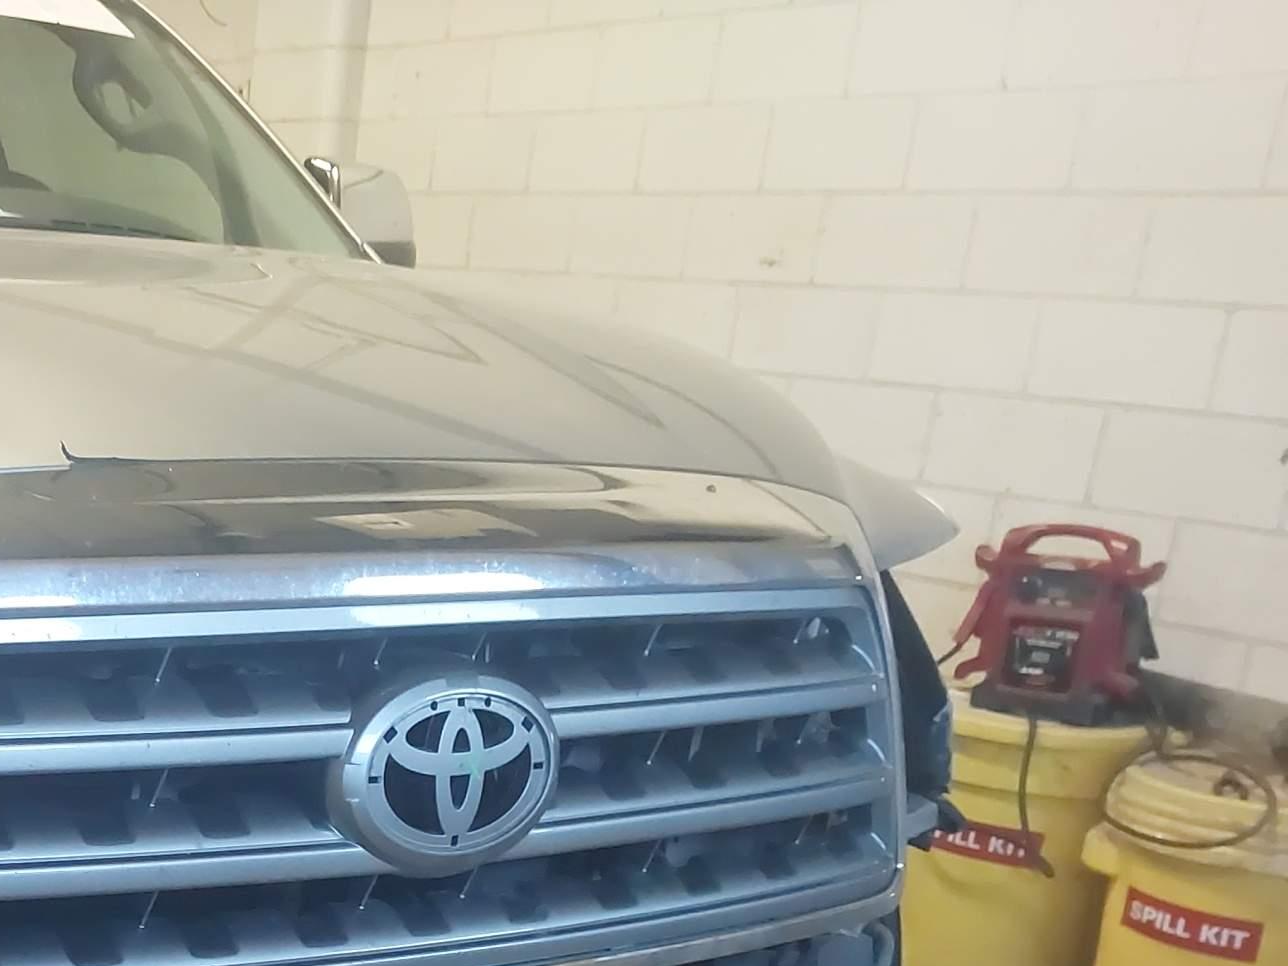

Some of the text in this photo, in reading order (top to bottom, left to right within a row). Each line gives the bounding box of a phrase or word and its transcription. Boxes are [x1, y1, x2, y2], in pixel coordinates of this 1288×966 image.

[933, 829, 981, 850] ILL
[1129, 900, 1251, 950] SPILL KIT
